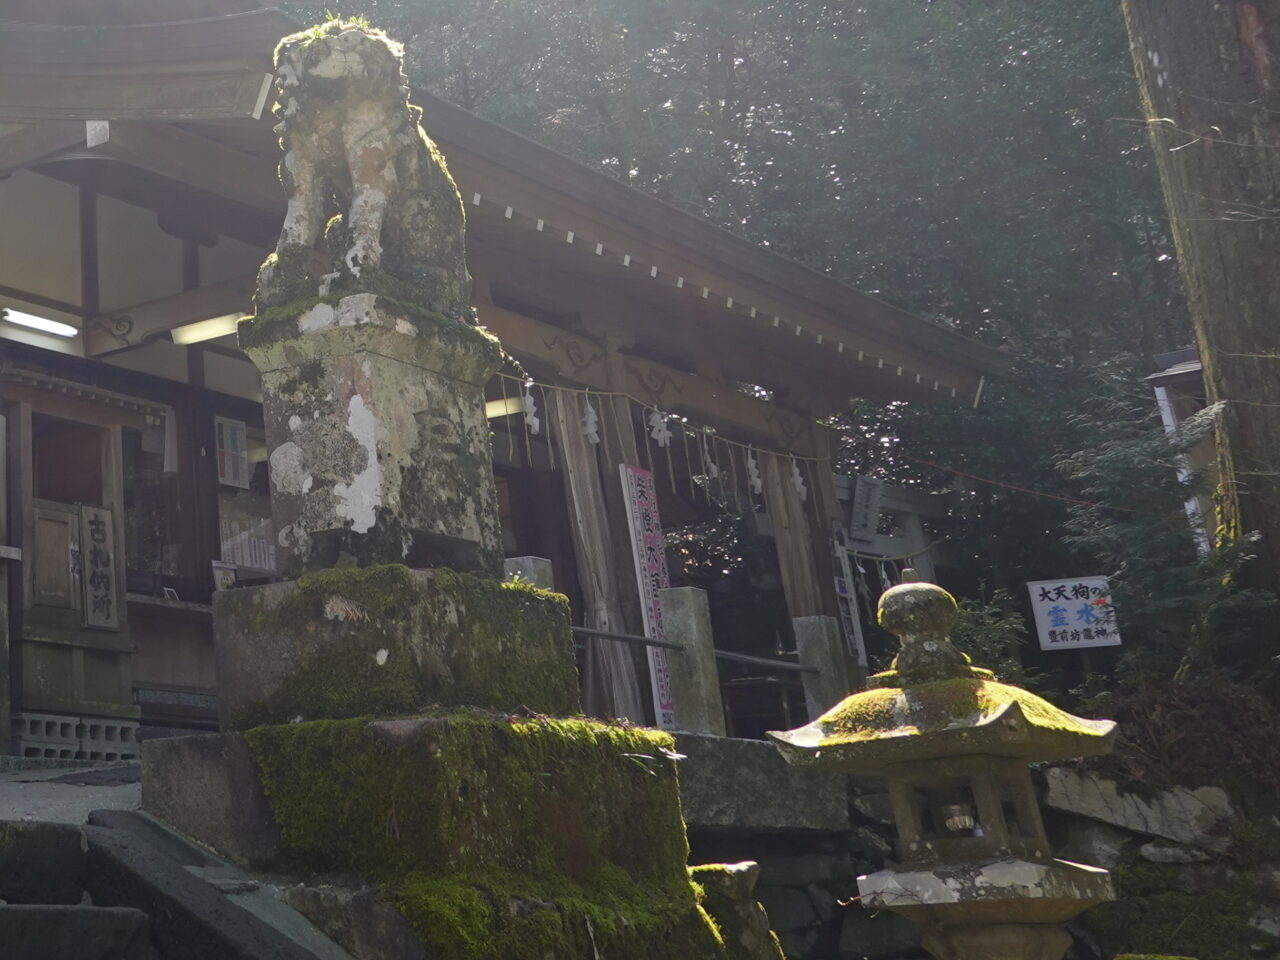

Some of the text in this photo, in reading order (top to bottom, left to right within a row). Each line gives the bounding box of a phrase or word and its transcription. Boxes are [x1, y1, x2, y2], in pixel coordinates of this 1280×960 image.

[88, 513, 112, 621] 古札納所
[1038, 583, 1101, 602] 大天狗の
[1047, 603, 1100, 628] 霊水
